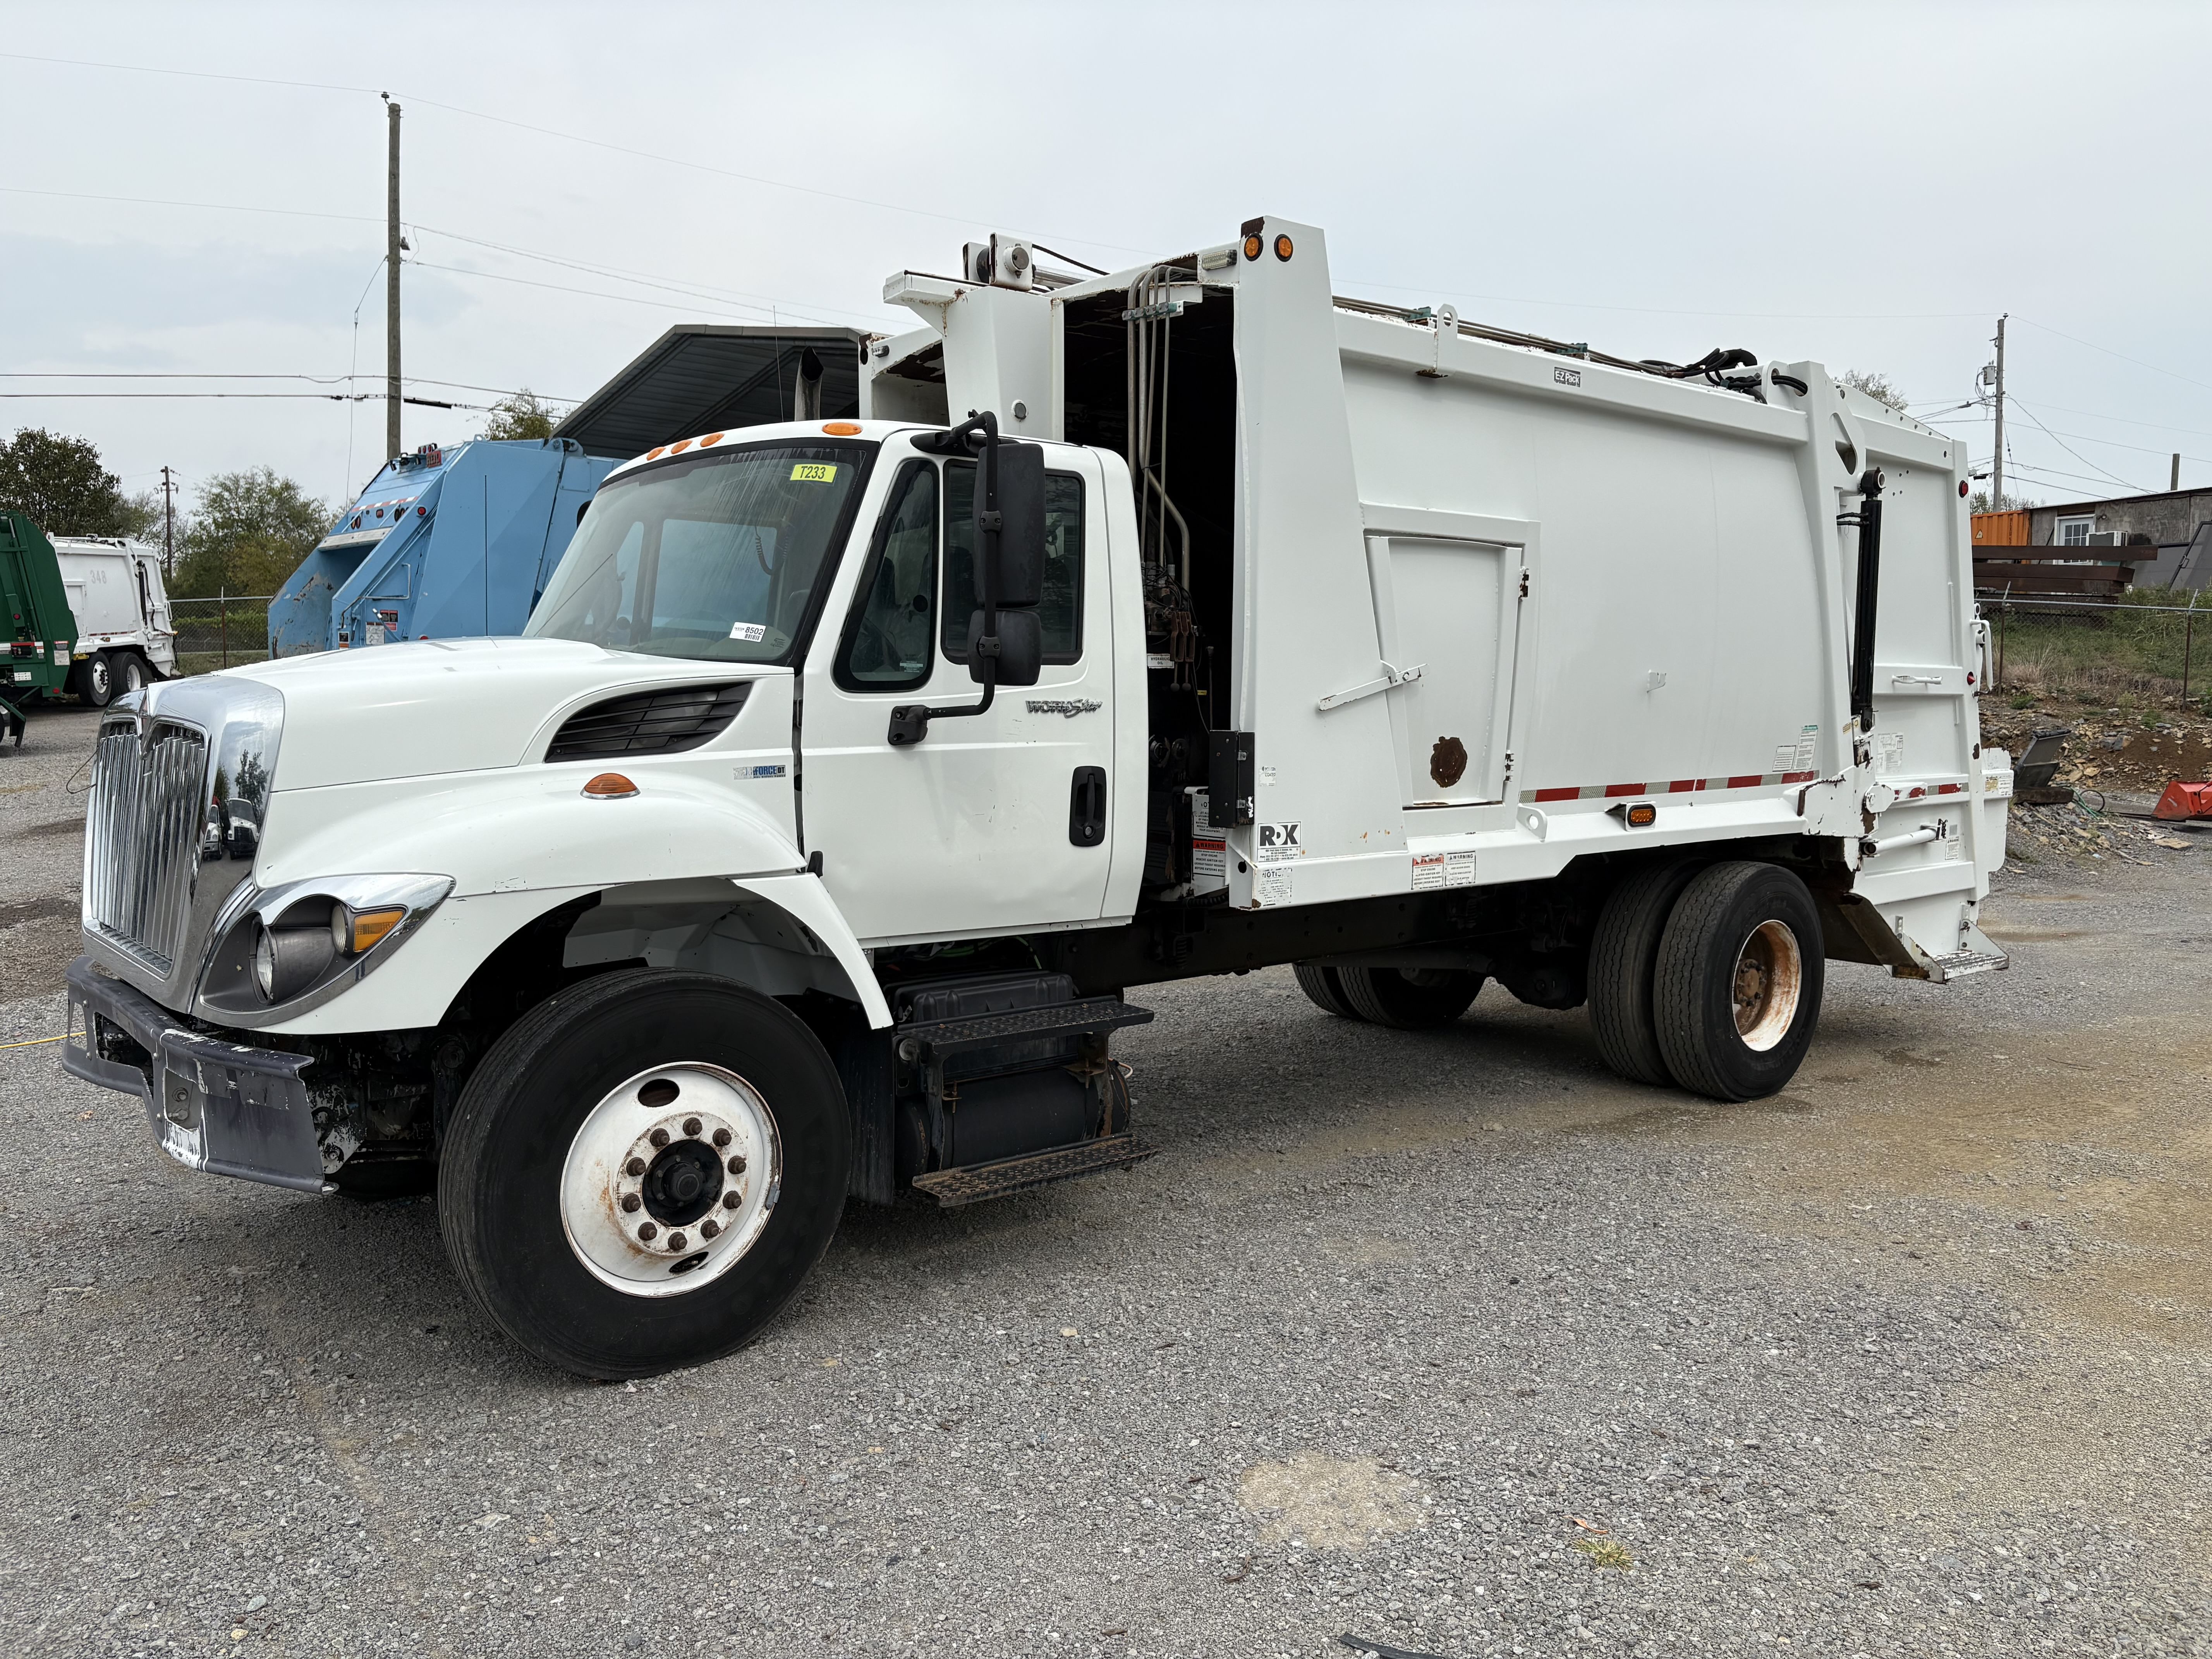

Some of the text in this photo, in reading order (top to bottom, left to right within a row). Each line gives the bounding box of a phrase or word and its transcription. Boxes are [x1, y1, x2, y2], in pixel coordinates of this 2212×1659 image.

[800, 466, 826, 479] T233
[90, 570, 106, 584] 348
[745, 627, 763, 635] 8502
[1260, 824, 1298, 846] RDK
